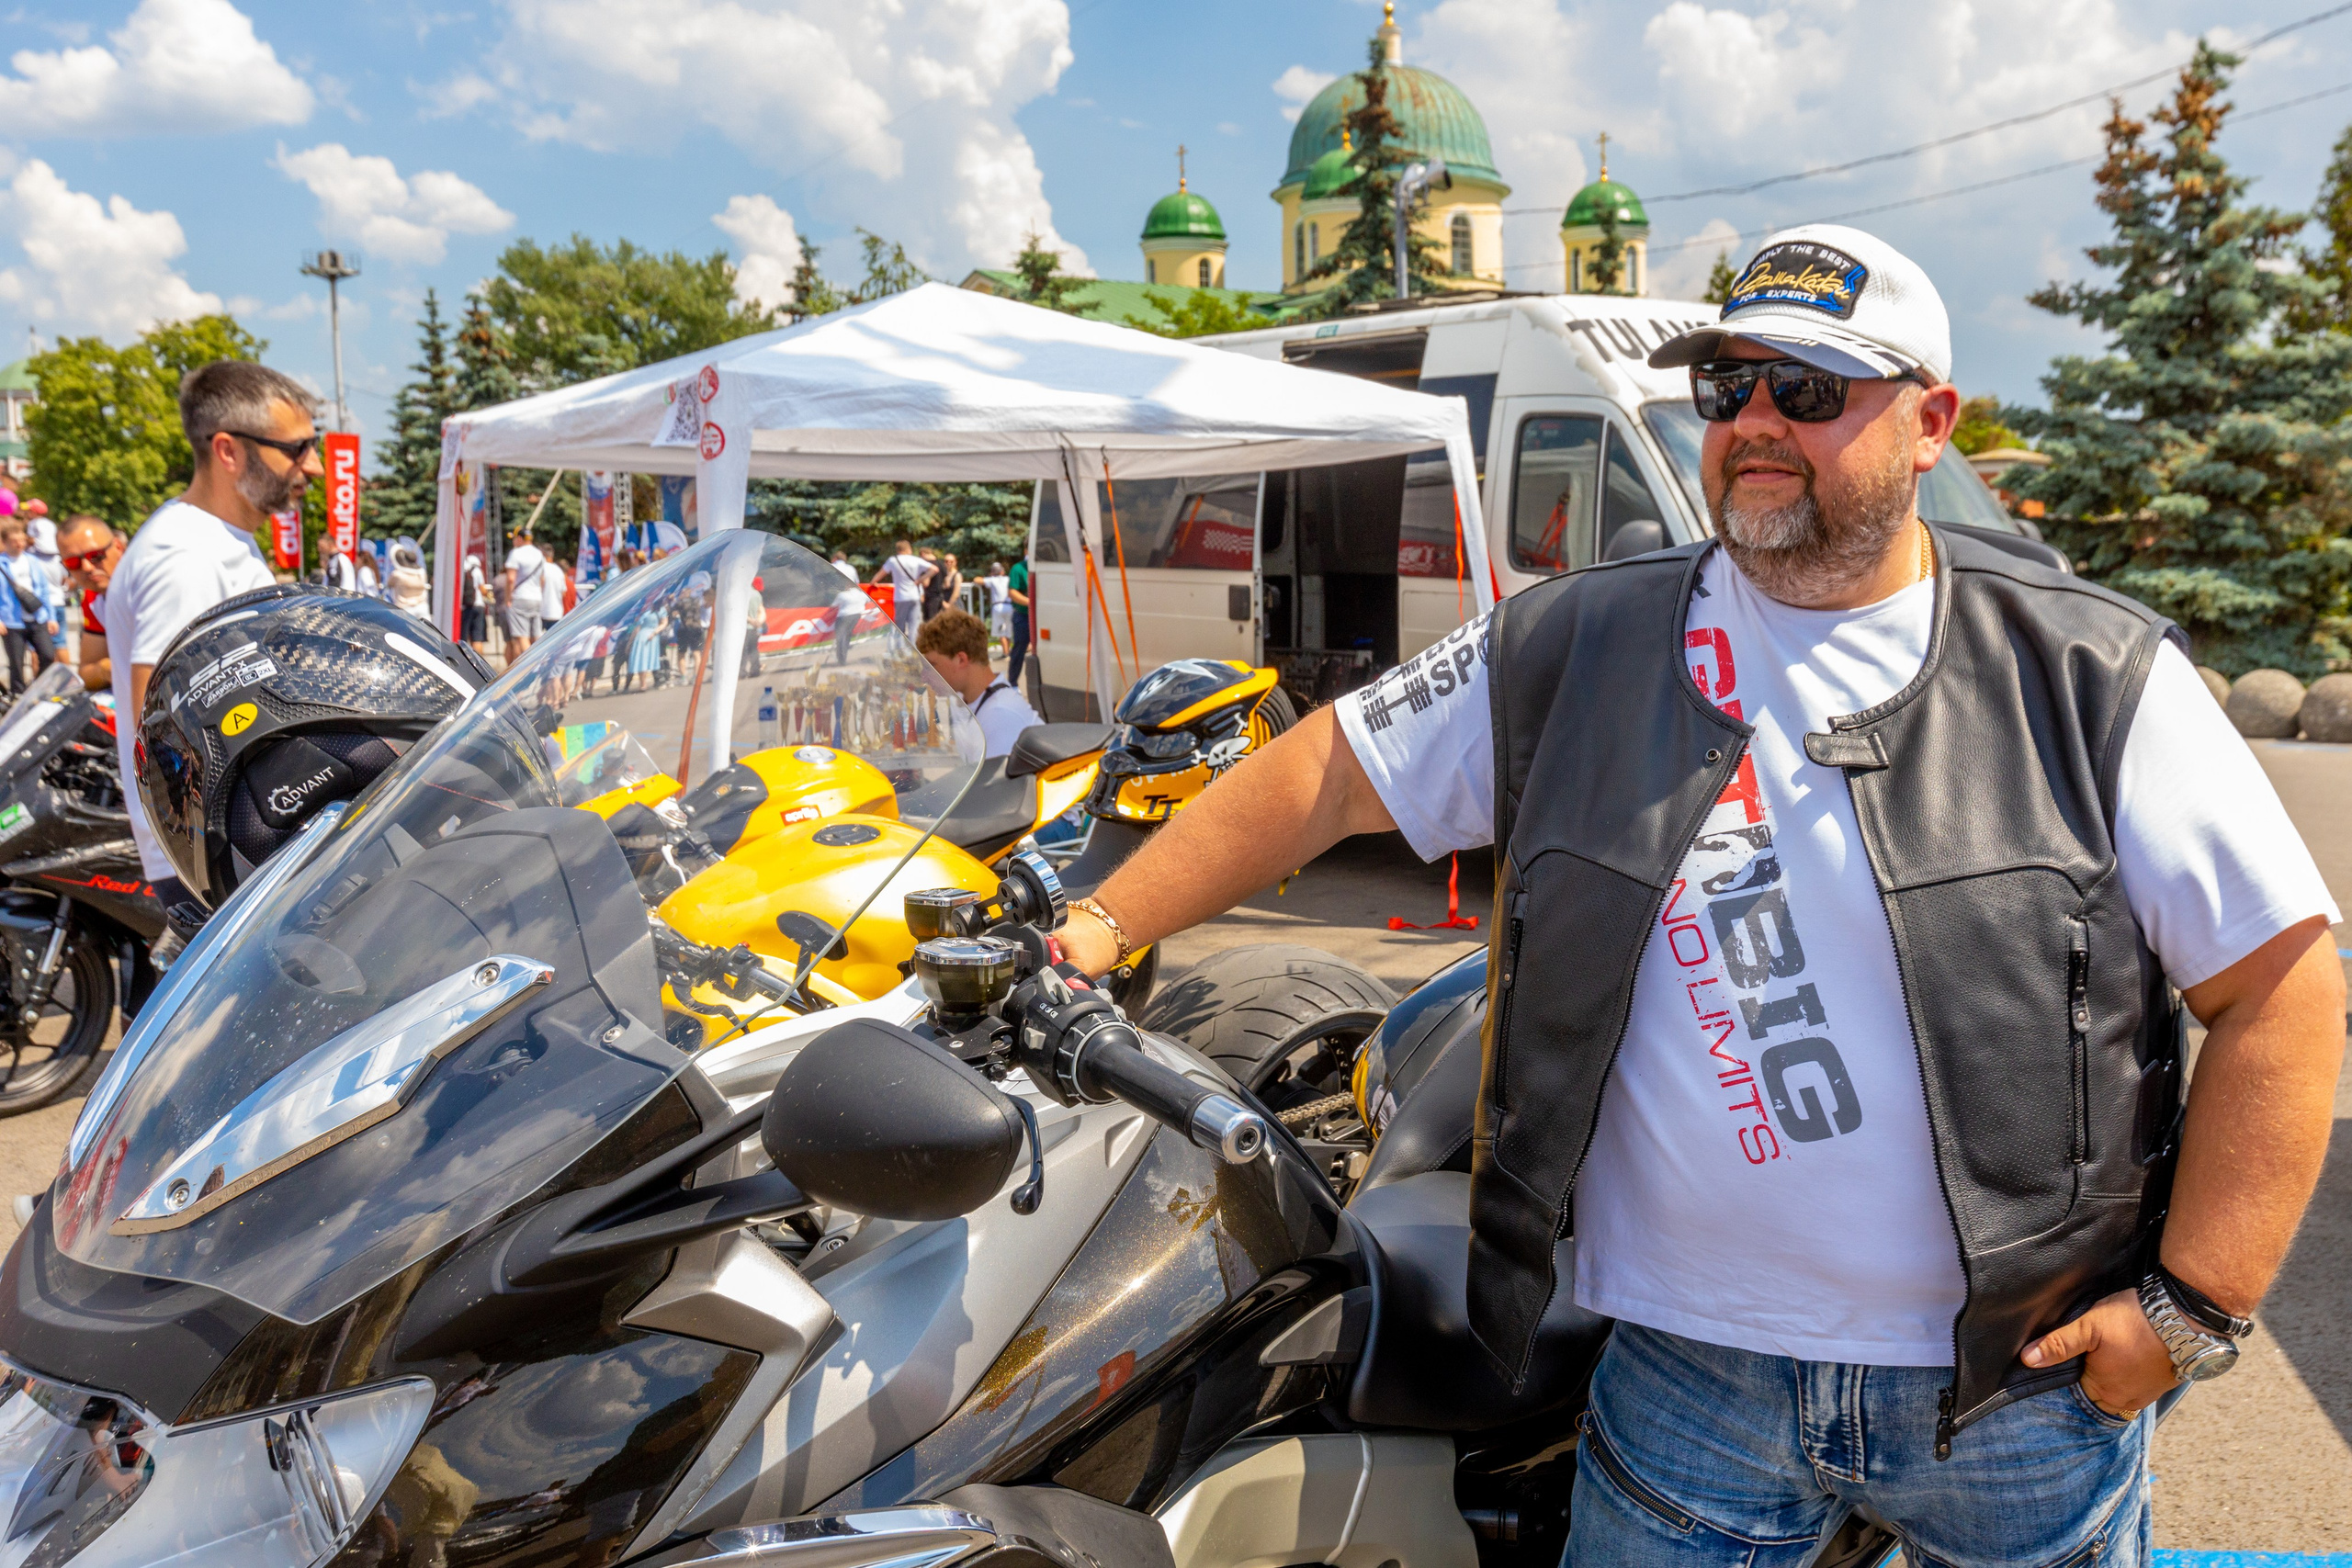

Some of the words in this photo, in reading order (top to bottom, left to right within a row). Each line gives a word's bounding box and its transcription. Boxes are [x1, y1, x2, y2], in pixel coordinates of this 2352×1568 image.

[1790, 243, 1815, 254] THE
[1818, 248, 1851, 270] BEST
[1738, 291, 1758, 304] FOR
[1766, 289, 1818, 303] EXPERTS
[334, 448, 356, 552] auto.ru
[170, 641, 258, 714] LS2
[233, 713, 250, 730] A
[280, 766, 335, 807] ADVANT
[1661, 877, 1710, 967] NO
[1707, 886, 1864, 1144] BIG
[1685, 976, 1781, 1165] LIMITS
